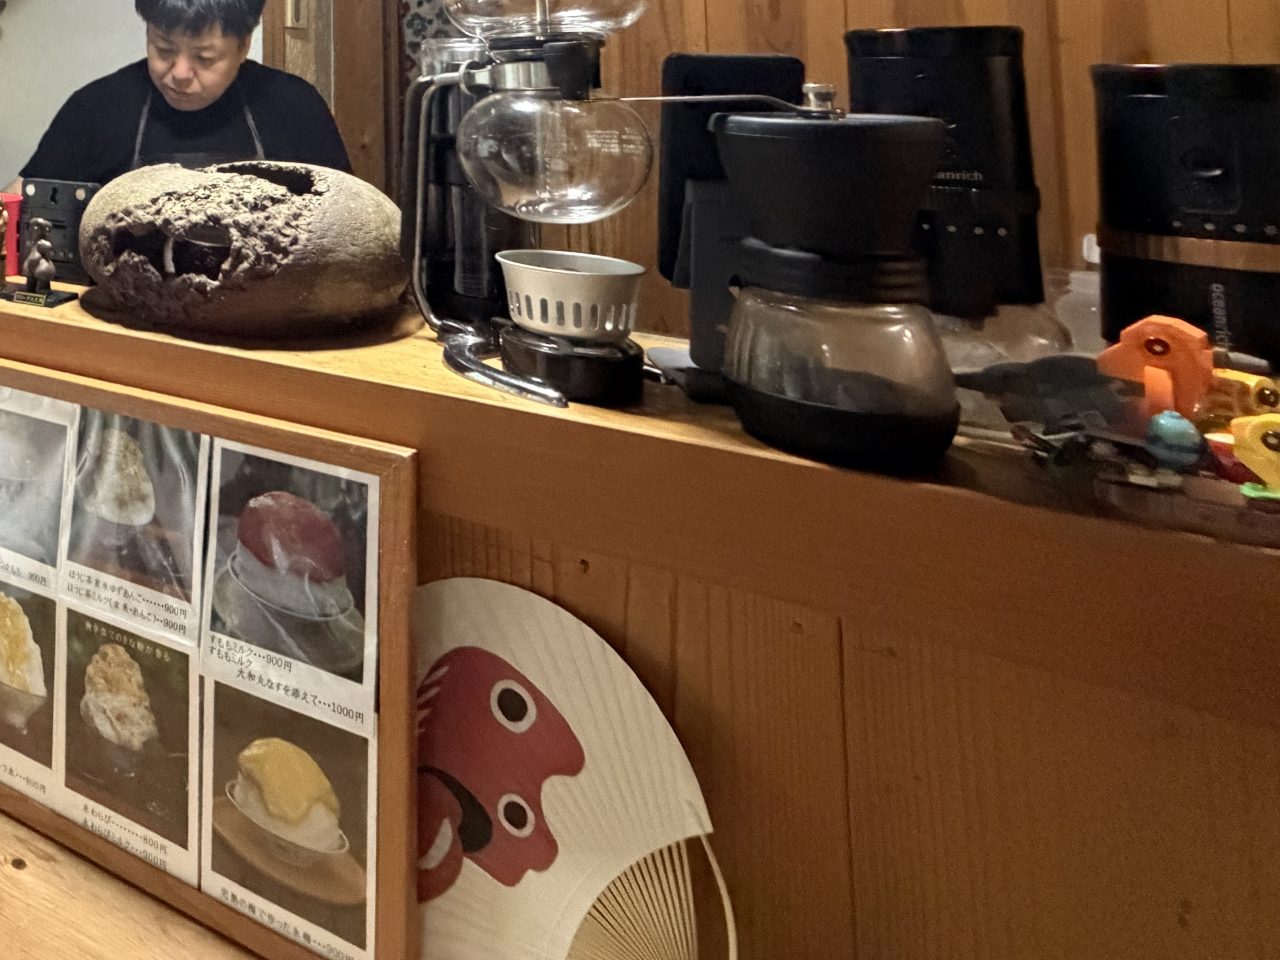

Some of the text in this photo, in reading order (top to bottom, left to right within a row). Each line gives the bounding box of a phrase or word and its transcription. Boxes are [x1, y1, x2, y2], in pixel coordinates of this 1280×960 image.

[934, 170, 983, 181] anrich
[208, 645, 253, 669] すももミルク
